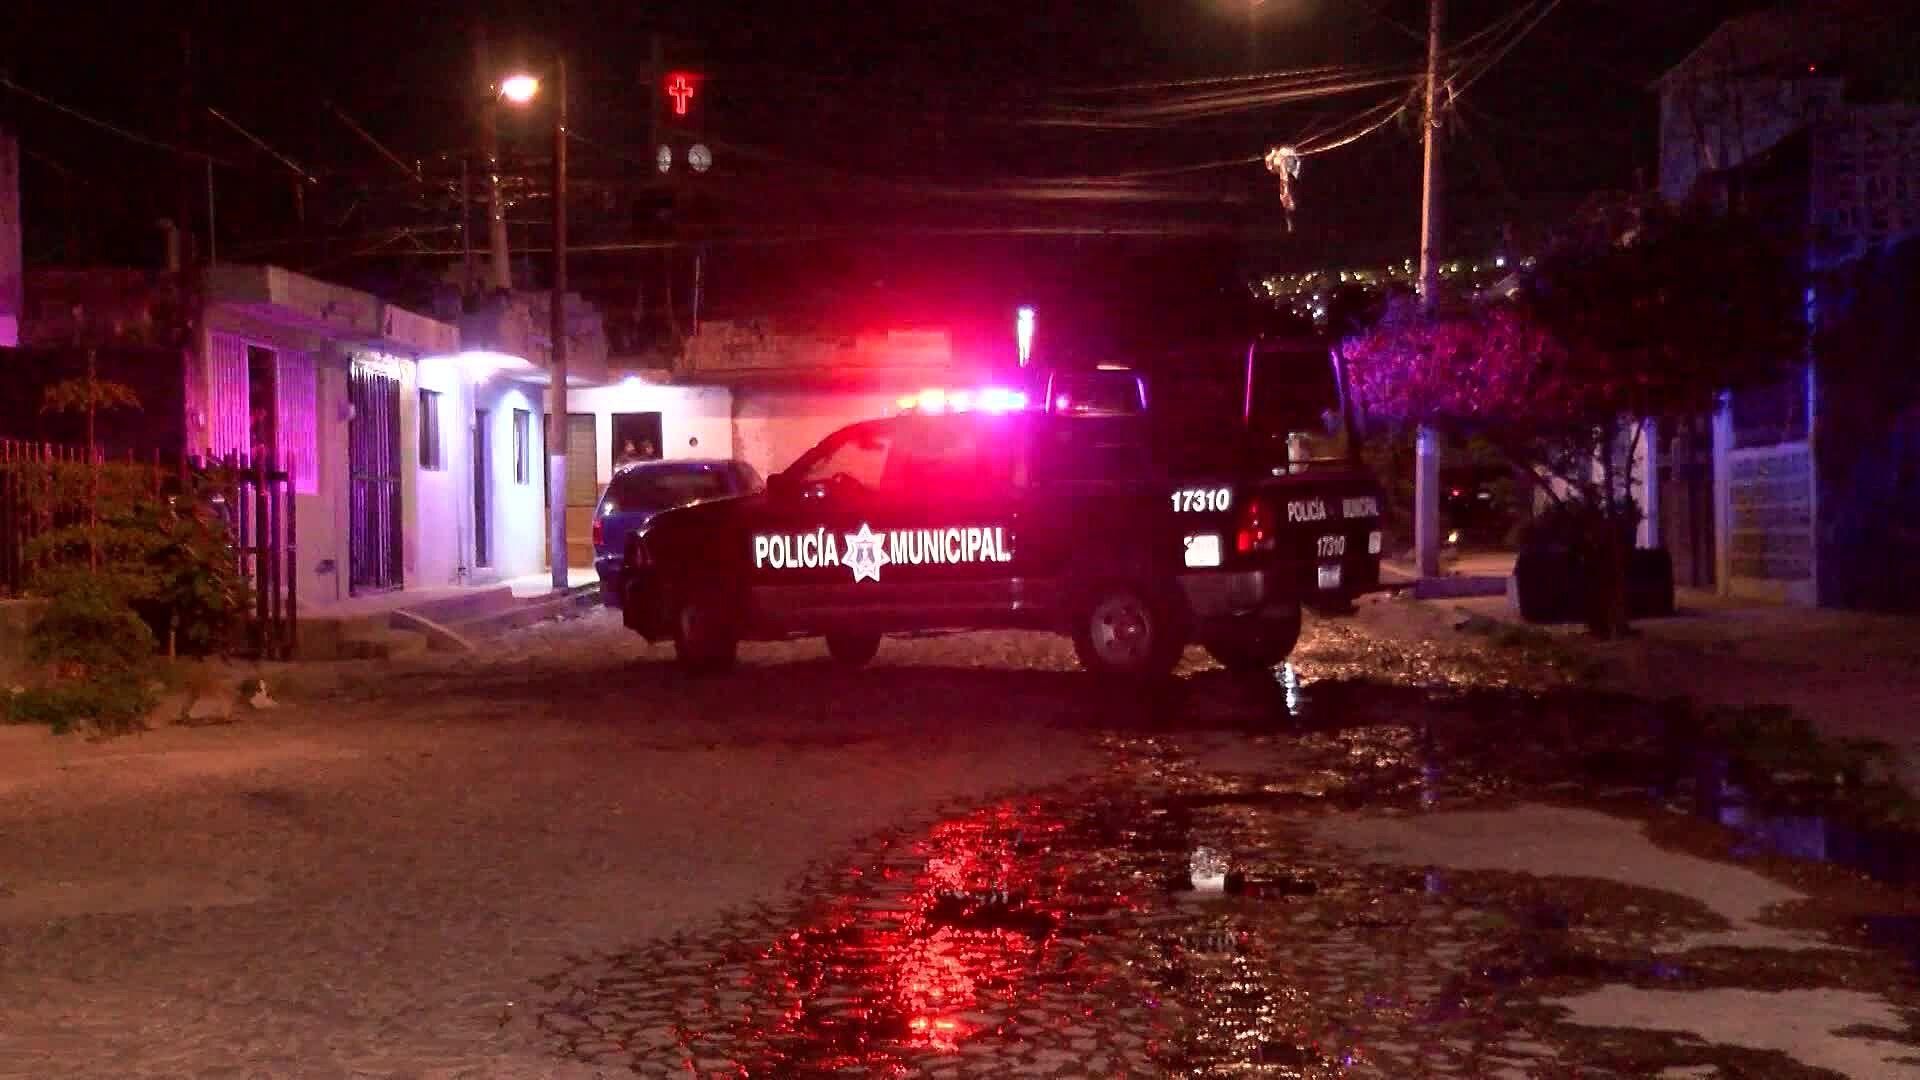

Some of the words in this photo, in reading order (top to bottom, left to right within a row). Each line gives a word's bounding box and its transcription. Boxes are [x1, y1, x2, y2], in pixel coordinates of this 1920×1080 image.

[1171, 488, 1230, 513] 17310
[755, 527, 839, 568] POLICÍA
[890, 527, 1011, 565] MUNICIPAL
[1317, 535, 1345, 557] 17310
